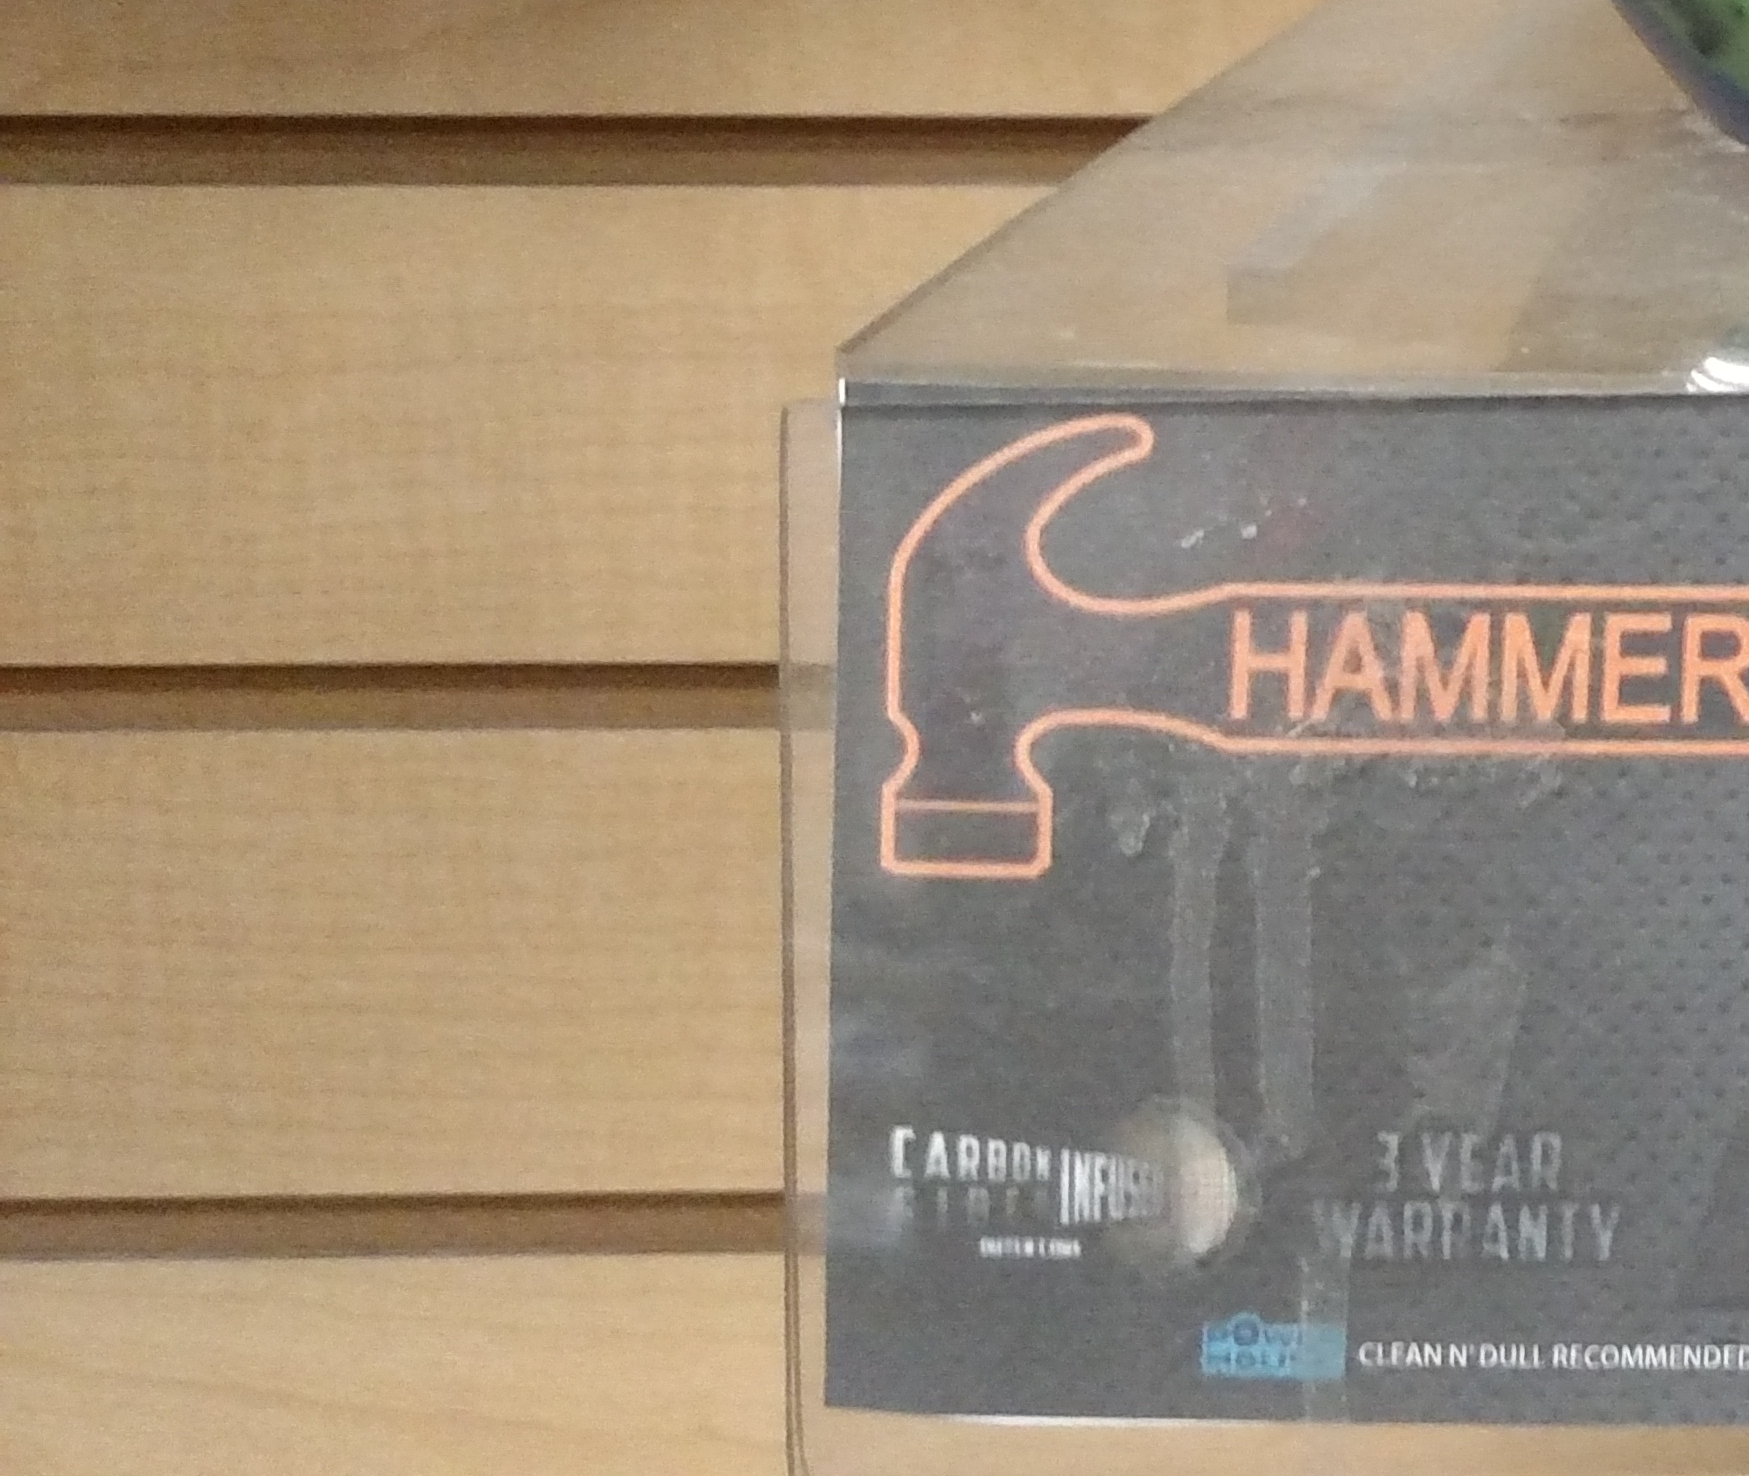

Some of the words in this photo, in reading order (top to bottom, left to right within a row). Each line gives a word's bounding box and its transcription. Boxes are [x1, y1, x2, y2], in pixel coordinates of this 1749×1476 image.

[889, 1125, 1052, 1183] CARBON
[1376, 1129, 1400, 1193] 3
[1420, 1129, 1563, 1194] YEAR
[1311, 1198, 1621, 1262] WARRANTY
[1357, 1339, 1443, 1368] CLEAN
[1479, 1342, 1546, 1370] DULL
